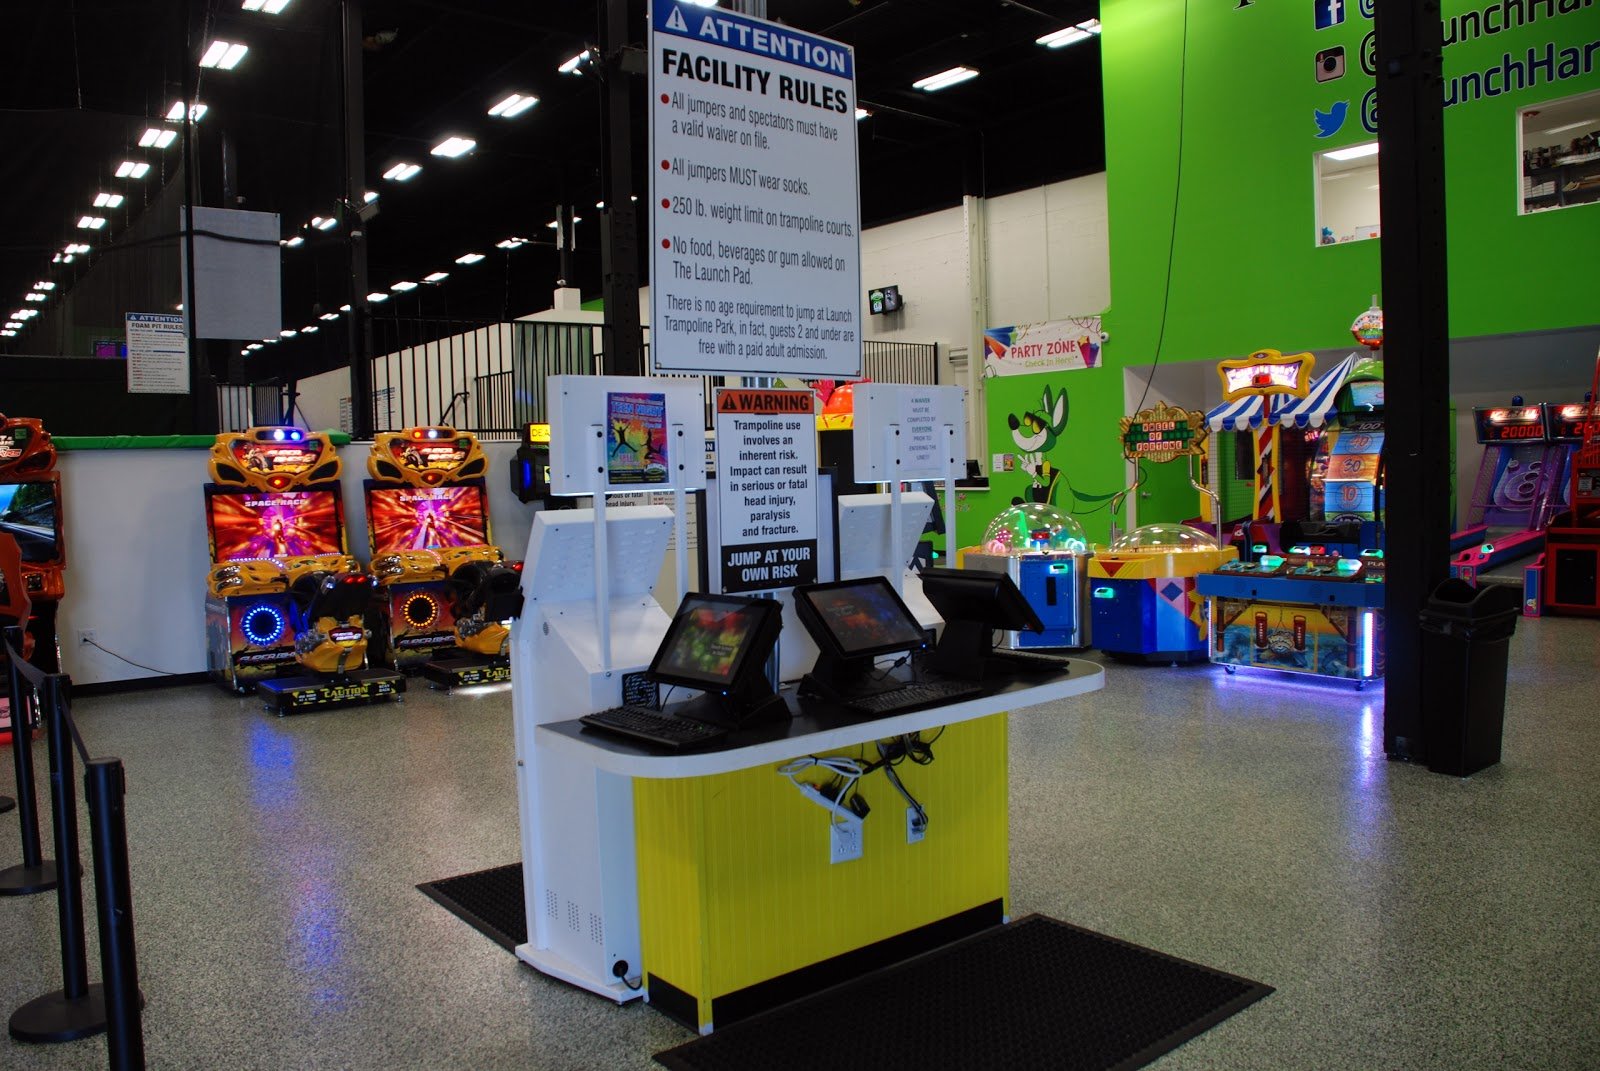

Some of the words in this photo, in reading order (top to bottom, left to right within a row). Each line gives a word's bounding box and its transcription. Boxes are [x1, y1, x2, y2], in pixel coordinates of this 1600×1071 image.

[699, 15, 846, 73] ATTENTION
[662, 48, 771, 95] FACILITY
[779, 74, 848, 114] RULES
[672, 91, 684, 110] All
[687, 94, 726, 119] jumpers
[729, 105, 746, 121] and
[748, 108, 794, 132] spectators
[796, 120, 817, 137] must
[819, 122, 838, 141] have
[672, 122, 678, 134] a
[681, 119, 704, 138] valid
[706, 125, 737, 144] waiver
[740, 131, 752, 146] on
[754, 131, 771, 150] file.
[672, 157, 684, 176] All
[687, 160, 727, 183] jumpers
[729, 166, 758, 187] MUST
[759, 173, 780, 190] wear
[782, 175, 811, 196] socks.
[672, 197, 693, 215] 250
[695, 201, 707, 217] lb.
[710, 204, 742, 224] weight
[744, 205, 764, 225] limit
[766, 212, 778, 227] on
[779, 212, 824, 233] trampoline
[826, 220, 854, 238] courts.
[673, 236, 687, 254] No
[690, 238, 715, 260] food,
[718, 241, 765, 265] beverages
[768, 248, 777, 263] or
[780, 250, 799, 268] gum
[801, 251, 833, 270] allowed
[835, 258, 846, 272] on
[673, 261, 692, 279] The
[695, 263, 730, 283] Launch
[733, 267, 753, 285] Pad.
[667, 294, 692, 311] There
[695, 296, 702, 312] is
[705, 299, 716, 313] no
[718, 301, 734, 316] age
[736, 302, 784, 318] requirement
[786, 304, 794, 317] to
[795, 305, 815, 322] jump
[817, 308, 824, 320] at
[826, 307, 852, 322] Launch
[664, 316, 713, 336] Trampoline
[715, 319, 737, 337] Park,
[739, 321, 747, 335] in
[749, 321, 767, 338] fact,
[769, 324, 796, 340] guests
[798, 324, 803, 339] 2
[804, 325, 819, 340] and
[821, 326, 841, 341] under
[843, 329, 855, 342] are
[698, 338, 716, 355] free
[718, 340, 736, 356] with
[738, 344, 744, 356] a
[745, 342, 763, 359] paid
[765, 342, 785, 358] adult
[786, 344, 828, 360] admission.
[1011, 344, 1042, 358] PARTY
[1047, 340, 1076, 355] ZONE
[738, 394, 810, 412] WARNING
[734, 420, 784, 434] Trampoline
[786, 421, 801, 431] use
[743, 436, 781, 446] involves
[783, 437, 793, 446] an
[739, 451, 777, 461] inherent
[779, 450, 798, 461] risk.
[730, 466, 762, 478] Impact
[764, 467, 780, 476] can
[783, 464, 807, 475] result
[730, 481, 738, 492] in
[741, 481, 775, 491] serious
[777, 481, 786, 490] or
[788, 479, 808, 489] fatal
[744, 496, 766, 506] head
[769, 495, 796, 508] injury,
[750, 510, 790, 524] paralysis
[742, 526, 759, 537] and
[761, 525, 799, 537] fracture.
[728, 552, 762, 567] JUMP
[765, 550, 779, 563] AT
[782, 547, 811, 562] YOUR
[741, 567, 769, 582] OWN
[772, 564, 798, 579] RISK
[324, 686, 368, 698] CAUTION
